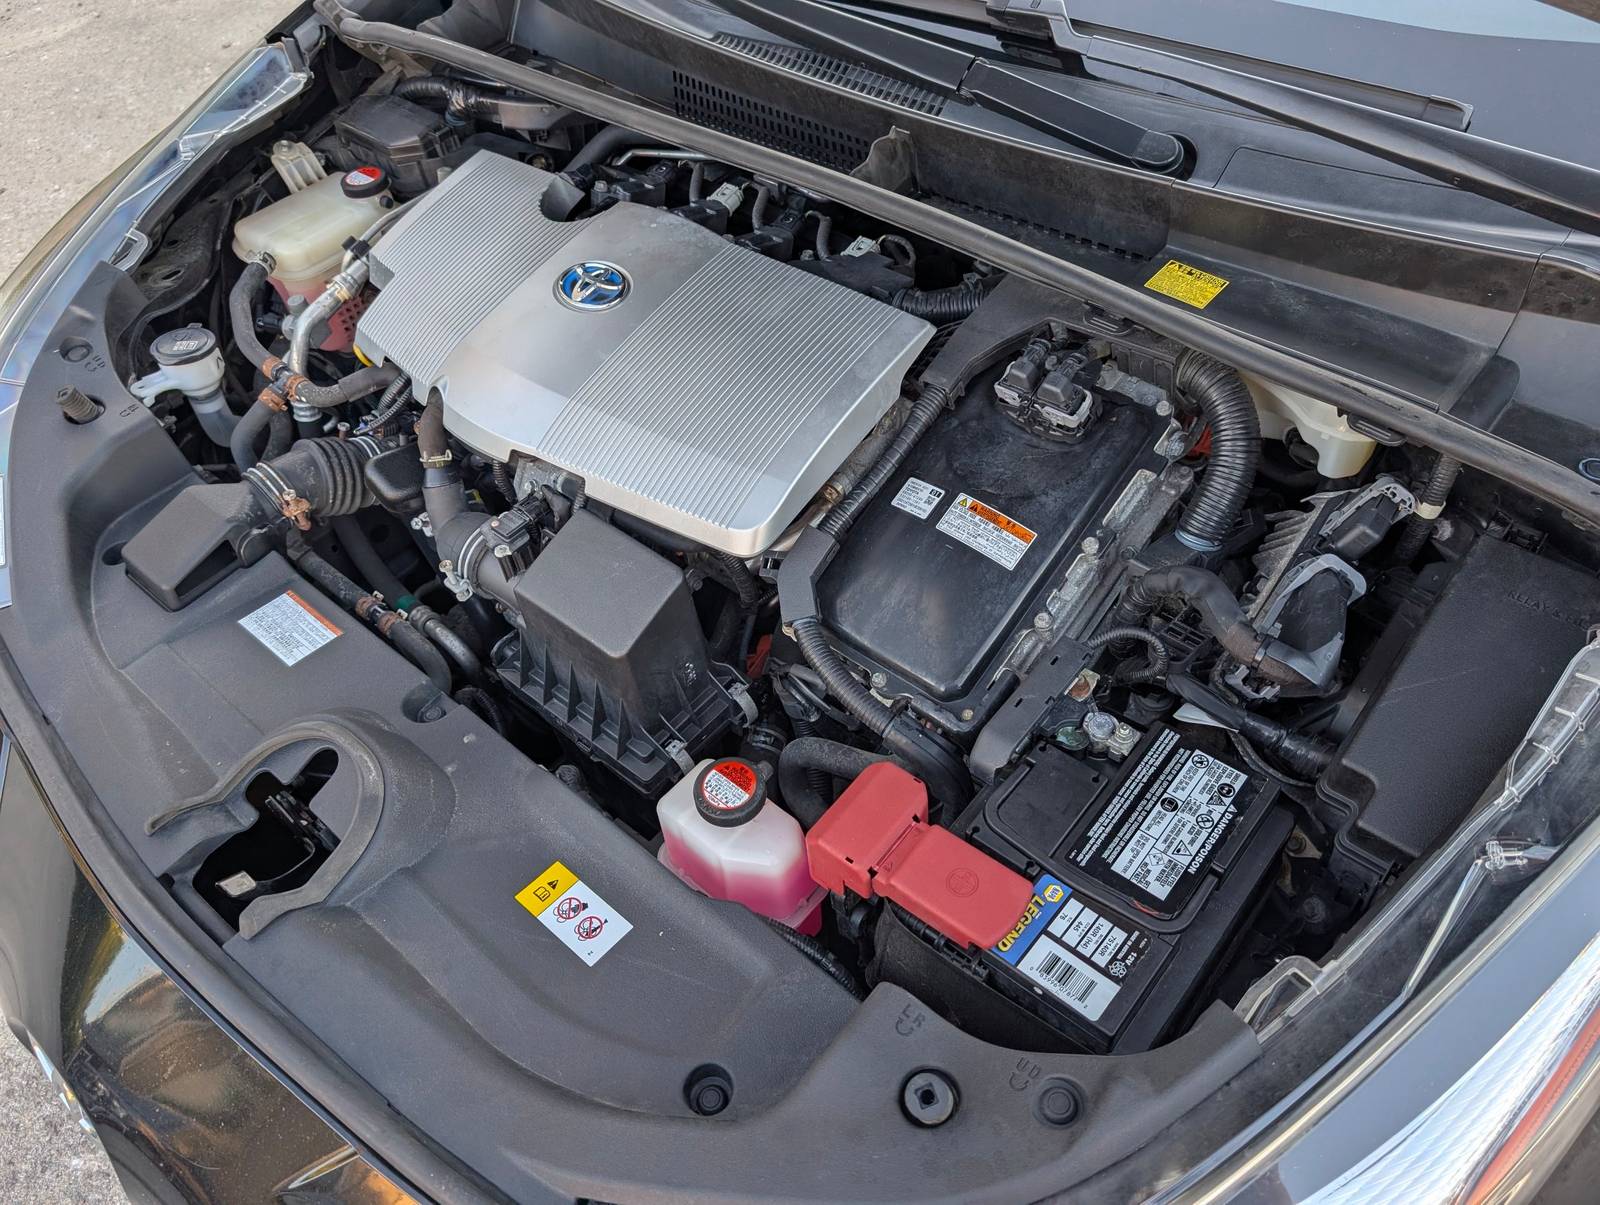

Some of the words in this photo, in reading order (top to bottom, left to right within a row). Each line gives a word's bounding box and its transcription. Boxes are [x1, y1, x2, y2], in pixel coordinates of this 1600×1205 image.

[1186, 811, 1233, 874] DANGER/POISON
[998, 896, 1046, 952] LEGEND
[1072, 919, 1083, 932] 445
[1090, 921, 1104, 937] 140R
[1080, 935, 1093, 950] (H4)
[1098, 933, 1117, 957] 75140R
[1124, 950, 1137, 966] 12V
